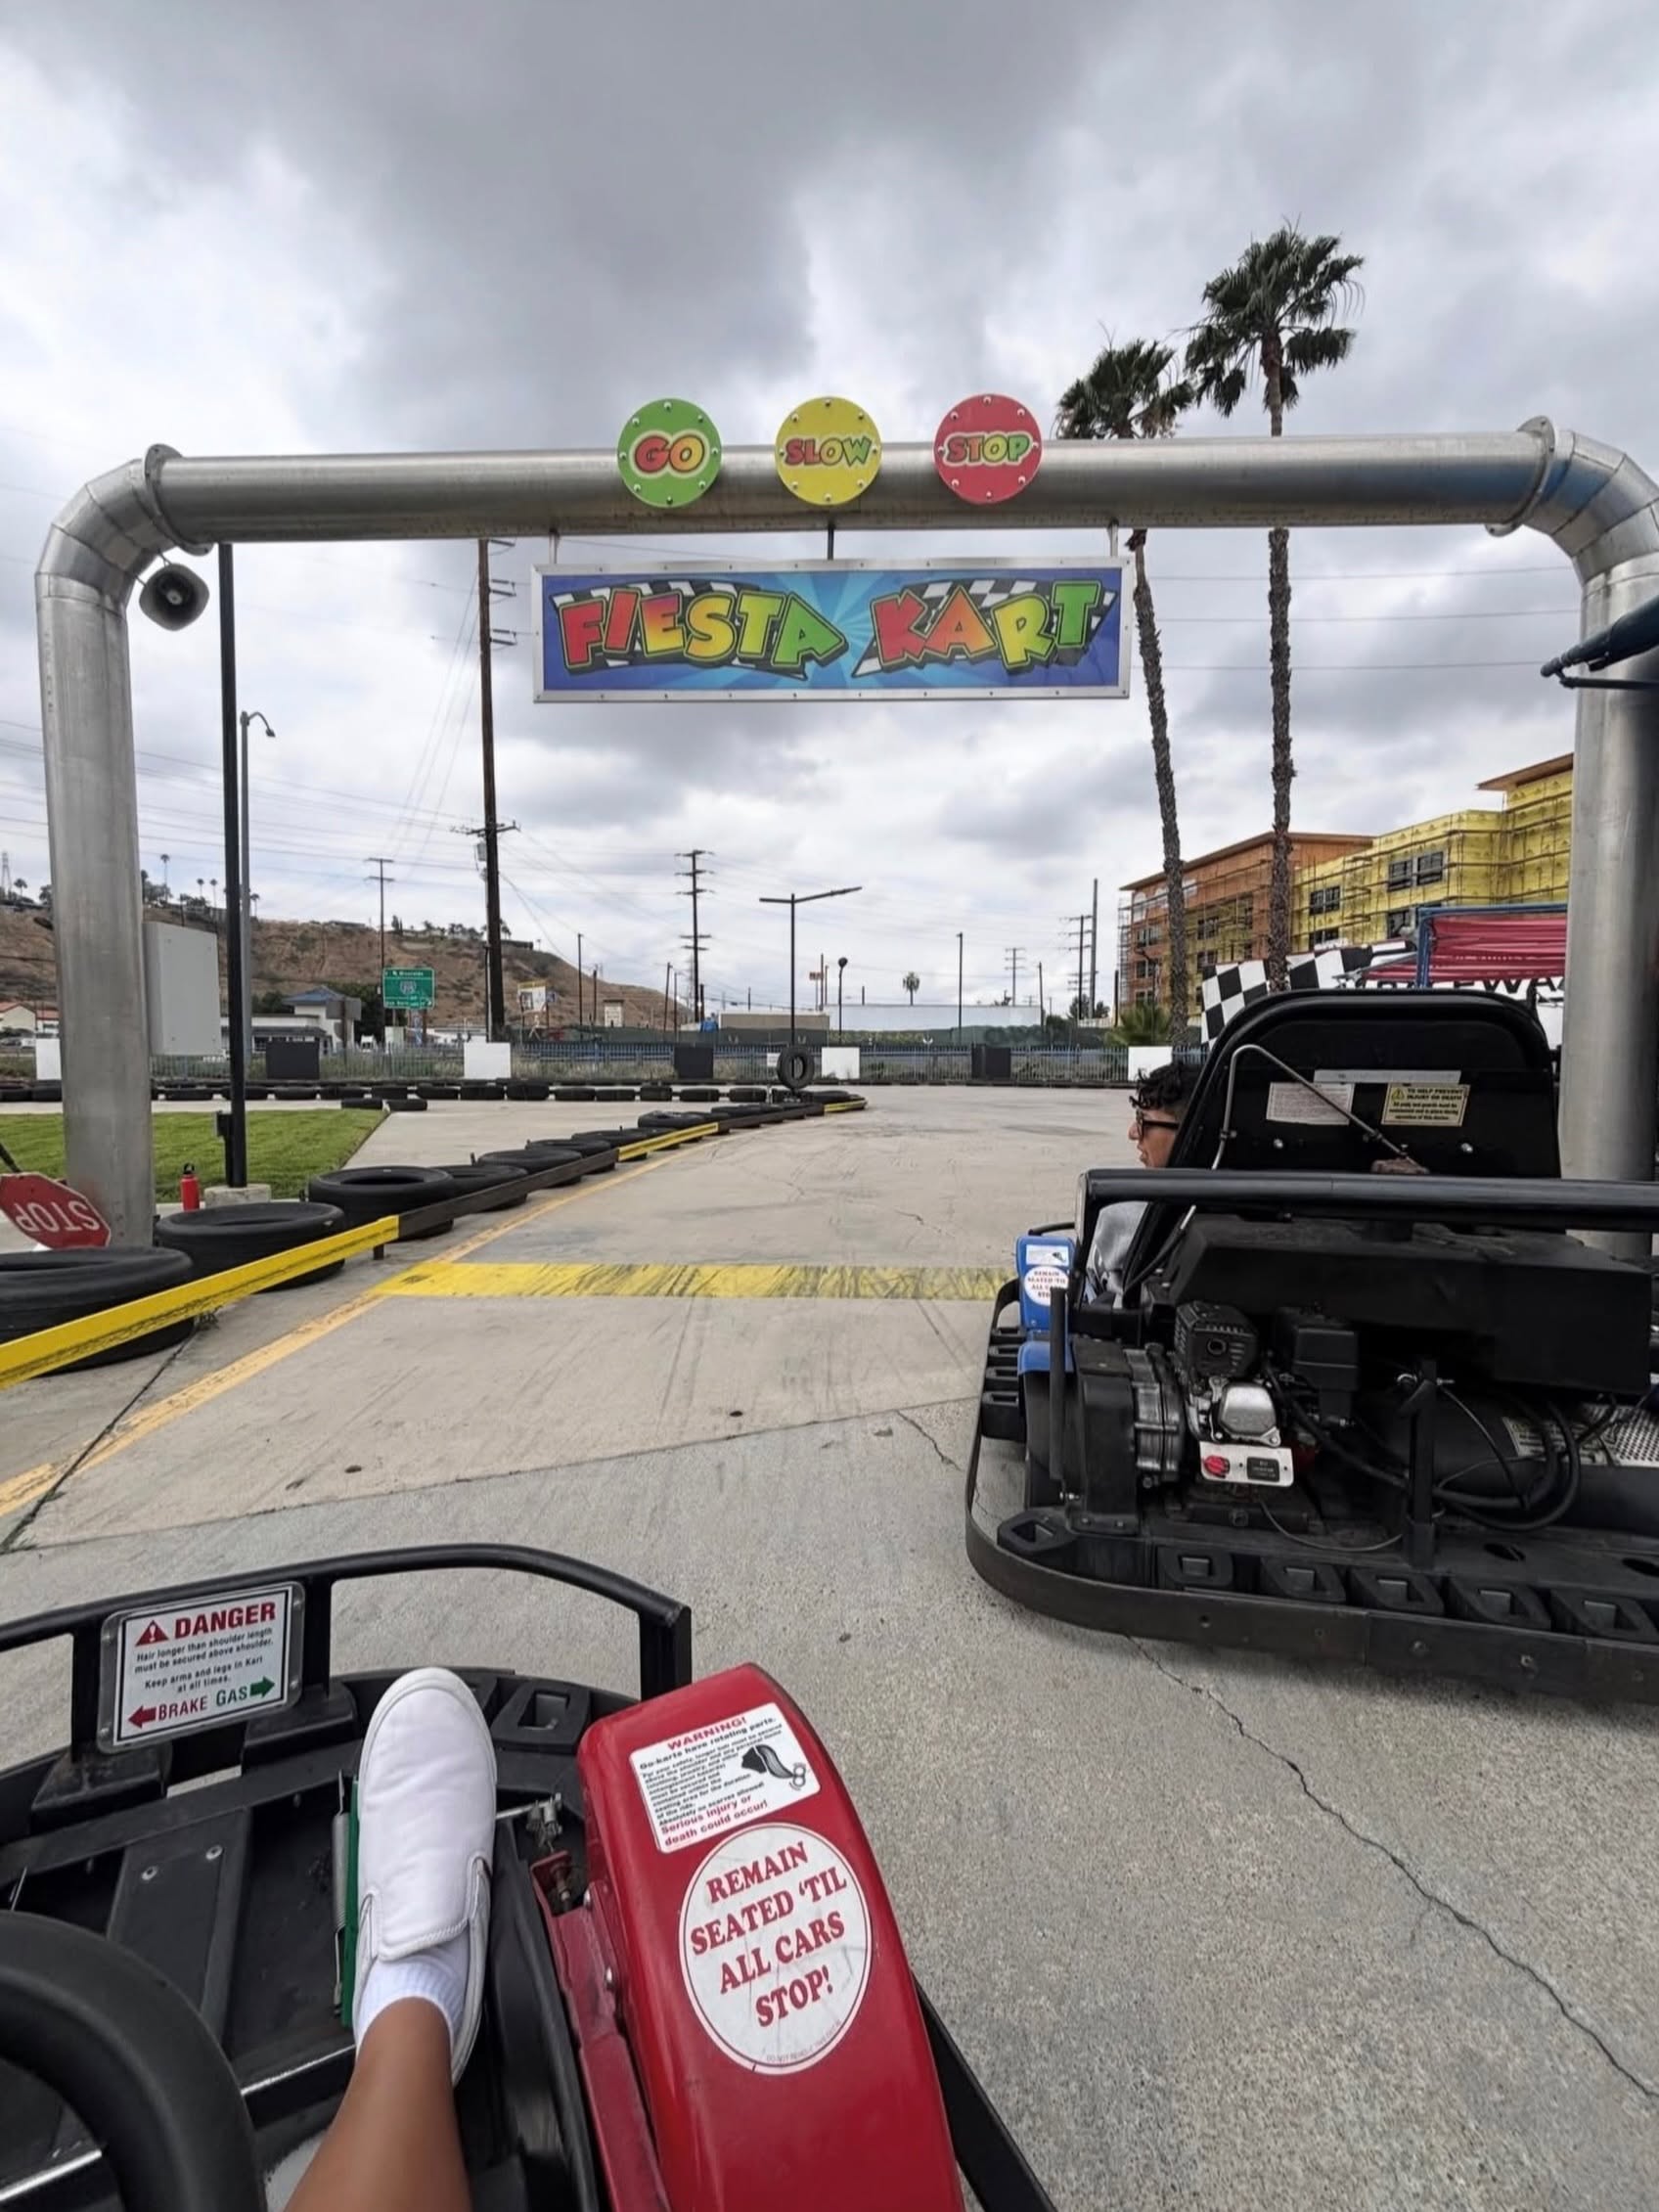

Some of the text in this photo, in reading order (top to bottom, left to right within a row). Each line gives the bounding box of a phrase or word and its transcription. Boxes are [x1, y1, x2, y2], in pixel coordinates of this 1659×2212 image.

[634, 434, 705, 474] GO
[785, 436, 872, 467] SLOW
[946, 435, 1030, 463] STOP
[560, 580, 1105, 673] FIESTA KART
[14, 1200, 100, 1232] STOP
[174, 1602, 275, 1639] DANGER
[135, 1661, 157, 1673] must
[172, 1651, 206, 1665] secured
[208, 1647, 233, 1658] above
[236, 1639, 273, 1651] shoulder.
[137, 1627, 272, 1661] Hair longer than shoulder length
[145, 1678, 167, 1689] Keep
[170, 1673, 192, 1683] arms
[195, 1667, 210, 1678] and
[213, 1664, 231, 1673] legs
[246, 1656, 262, 1666] Kart
[177, 1675, 231, 1693] at all times.
[158, 1686, 247, 1721] BRAKE GAS
[640, 1718, 776, 1769] Go-karts have rotating parts.
[655, 1766, 670, 1775] your
[731, 1737, 746, 1745] must
[757, 1723, 782, 1737] secured
[667, 1717, 745, 1750] WARNING!
[645, 1774, 664, 1783] above
[679, 1757, 707, 1771] shoulder
[736, 1737, 762, 1751] personal
[650, 1791, 668, 1800] must
[680, 1777, 706, 1790] secured
[652, 1791, 686, 1807] contained
[654, 1800, 681, 1813] seating
[683, 1794, 697, 1803] area
[723, 1774, 750, 1786] duration
[659, 1809, 695, 1828] Absolutely
[708, 1793, 735, 1807] scarves
[661, 1794, 750, 1834] Serious injury or
[665, 1799, 767, 1846] death could occur!
[706, 1841, 808, 1904] REMAIN
[691, 1890, 794, 1955] SEATED
[720, 1911, 844, 1994] ALL CARS
[756, 1964, 833, 2027] STOP!
